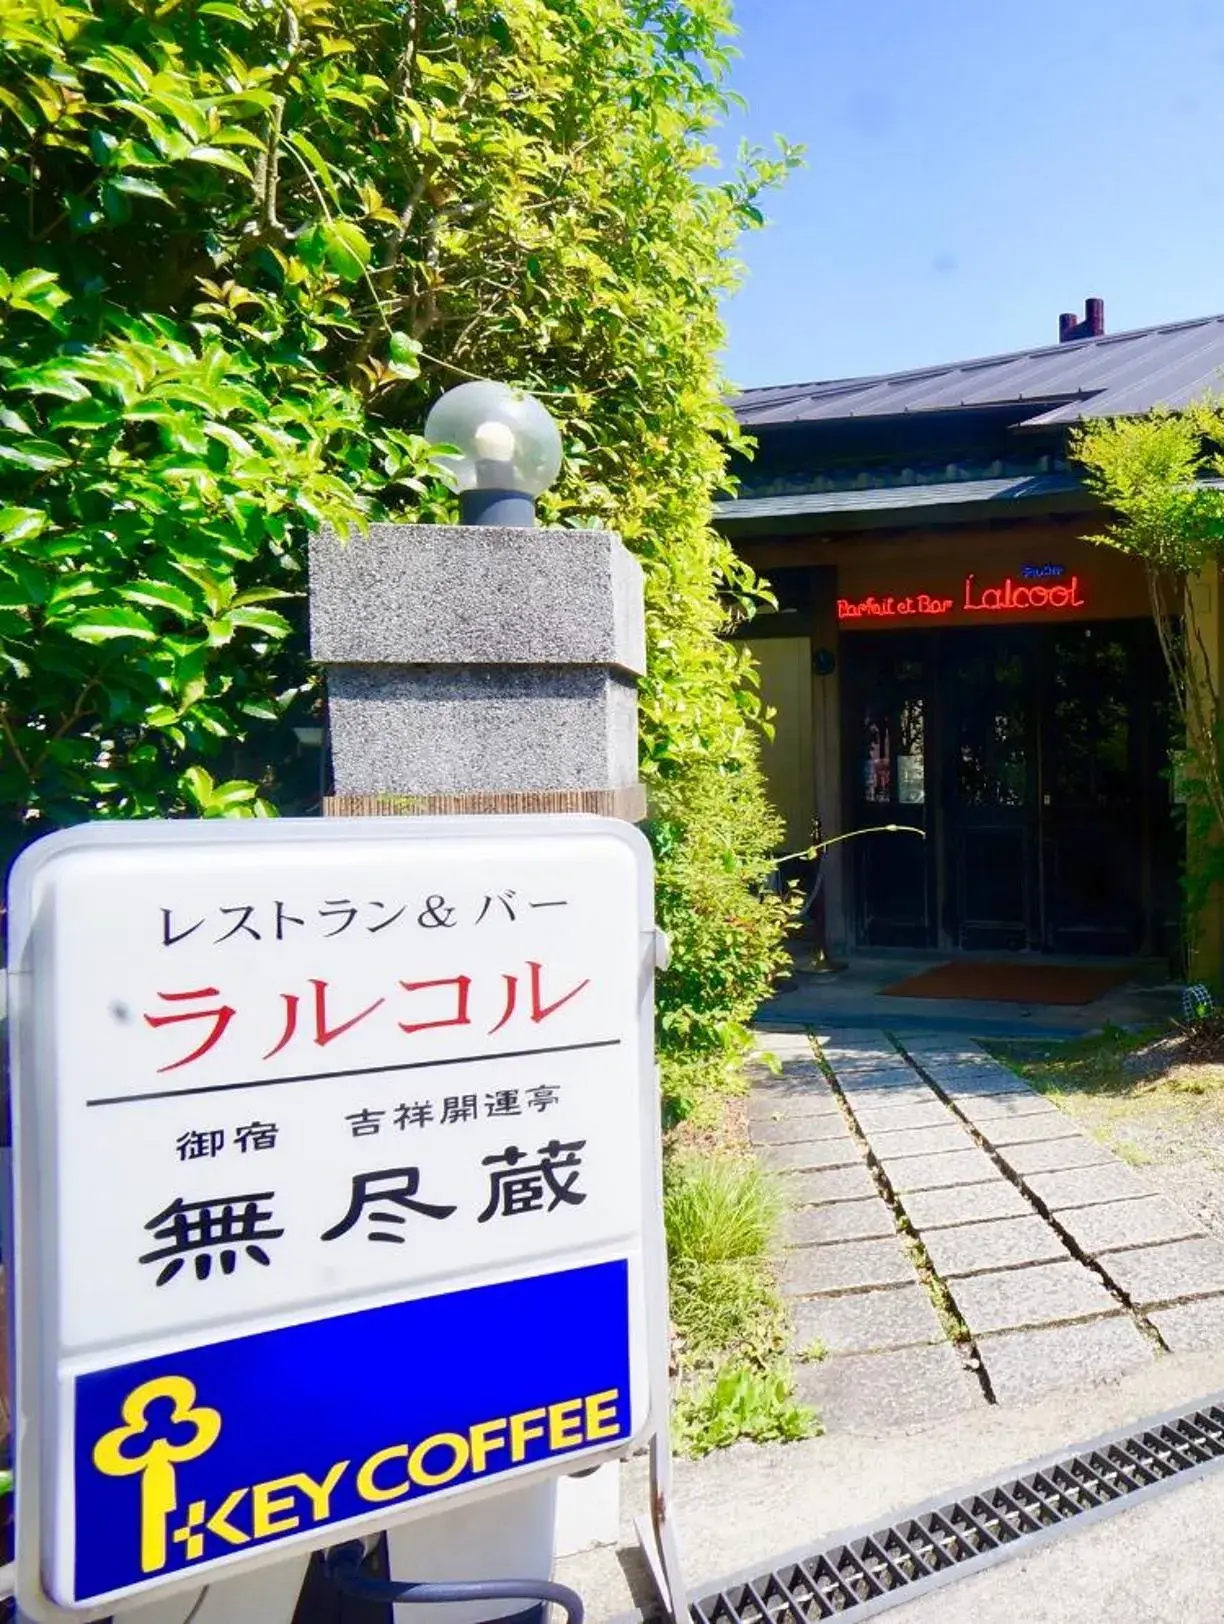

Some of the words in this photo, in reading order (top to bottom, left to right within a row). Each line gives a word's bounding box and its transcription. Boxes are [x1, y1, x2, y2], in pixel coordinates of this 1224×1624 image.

[917, 594, 953, 614] Bar
[142, 960, 591, 1074] ラルコル
[175, 1120, 280, 1161] 御宿
[344, 1083, 563, 1138] 吉祥開運亭
[138, 1138, 588, 1288] 無尽蔵
[173, 1459, 350, 1561] KEY
[355, 1388, 621, 1503] COFFEE
